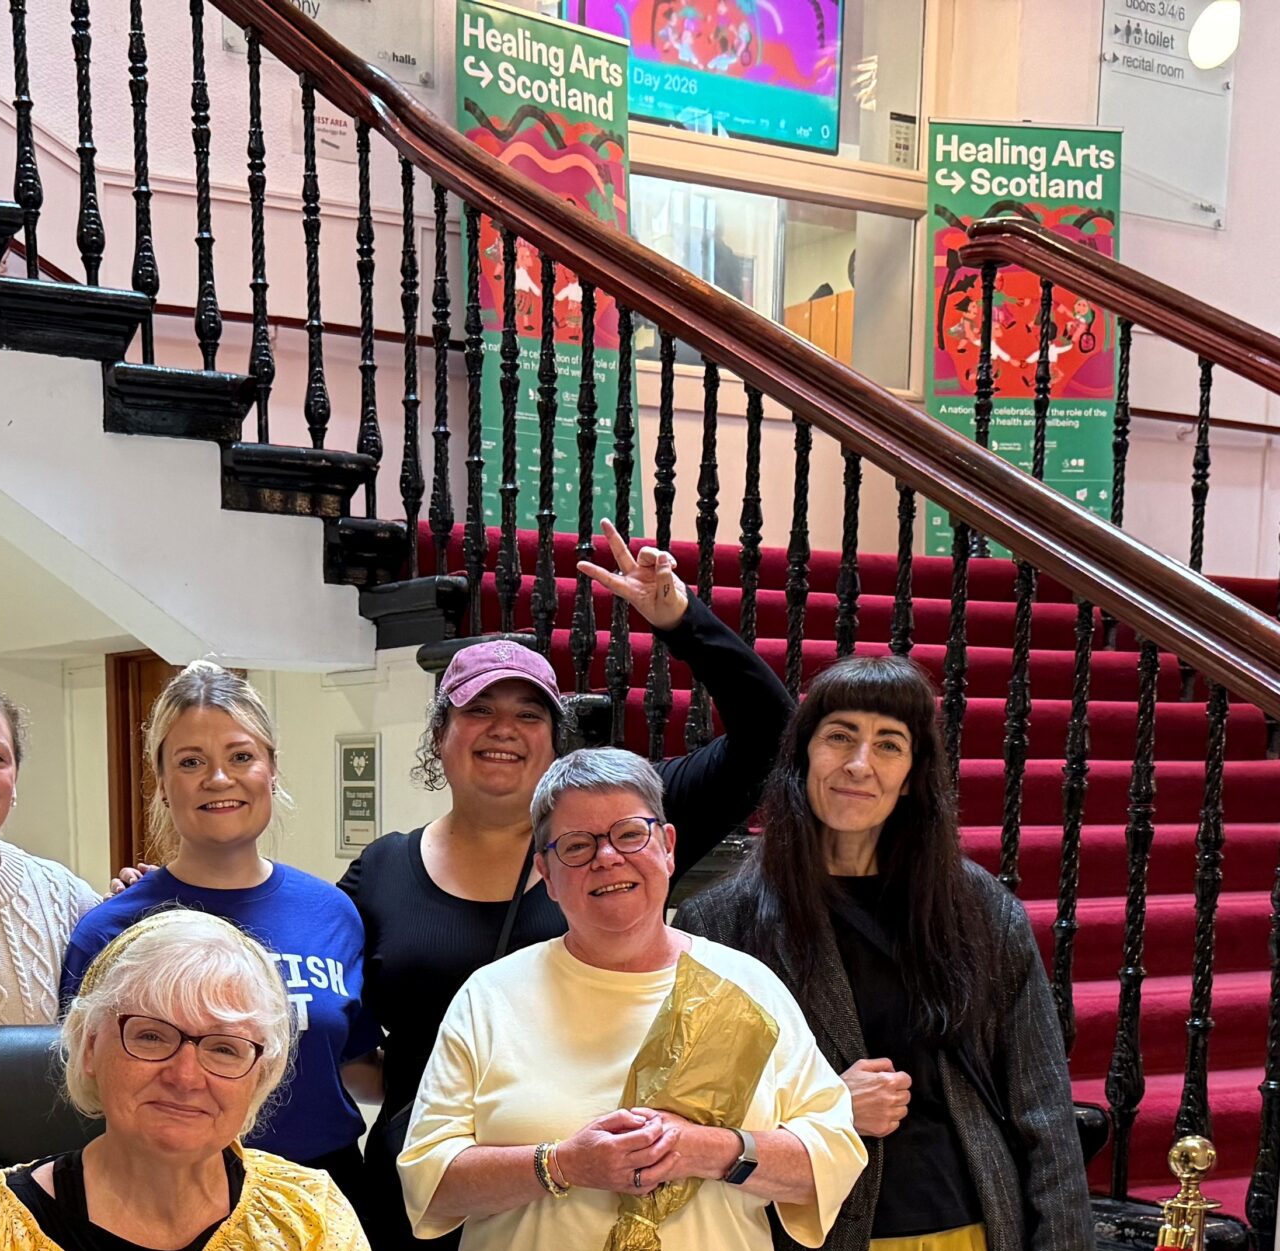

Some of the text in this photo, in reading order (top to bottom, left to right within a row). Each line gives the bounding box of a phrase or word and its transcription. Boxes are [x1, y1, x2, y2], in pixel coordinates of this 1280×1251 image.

[463, 13, 624, 87] Healing Arts
[1144, 28, 1175, 50] toilet
[633, 67, 698, 95] Day 2026
[1122, 54, 1185, 80] recital room
[497, 61, 614, 121] Scotland
[935, 134, 1115, 172] Healing Arts
[970, 168, 1103, 200] Scotland
[996, 418, 1022, 426] health
[1051, 407, 1065, 416] the
[1066, 408, 1082, 416] role
[1083, 408, 1093, 416] of
[1093, 408, 1107, 417] the
